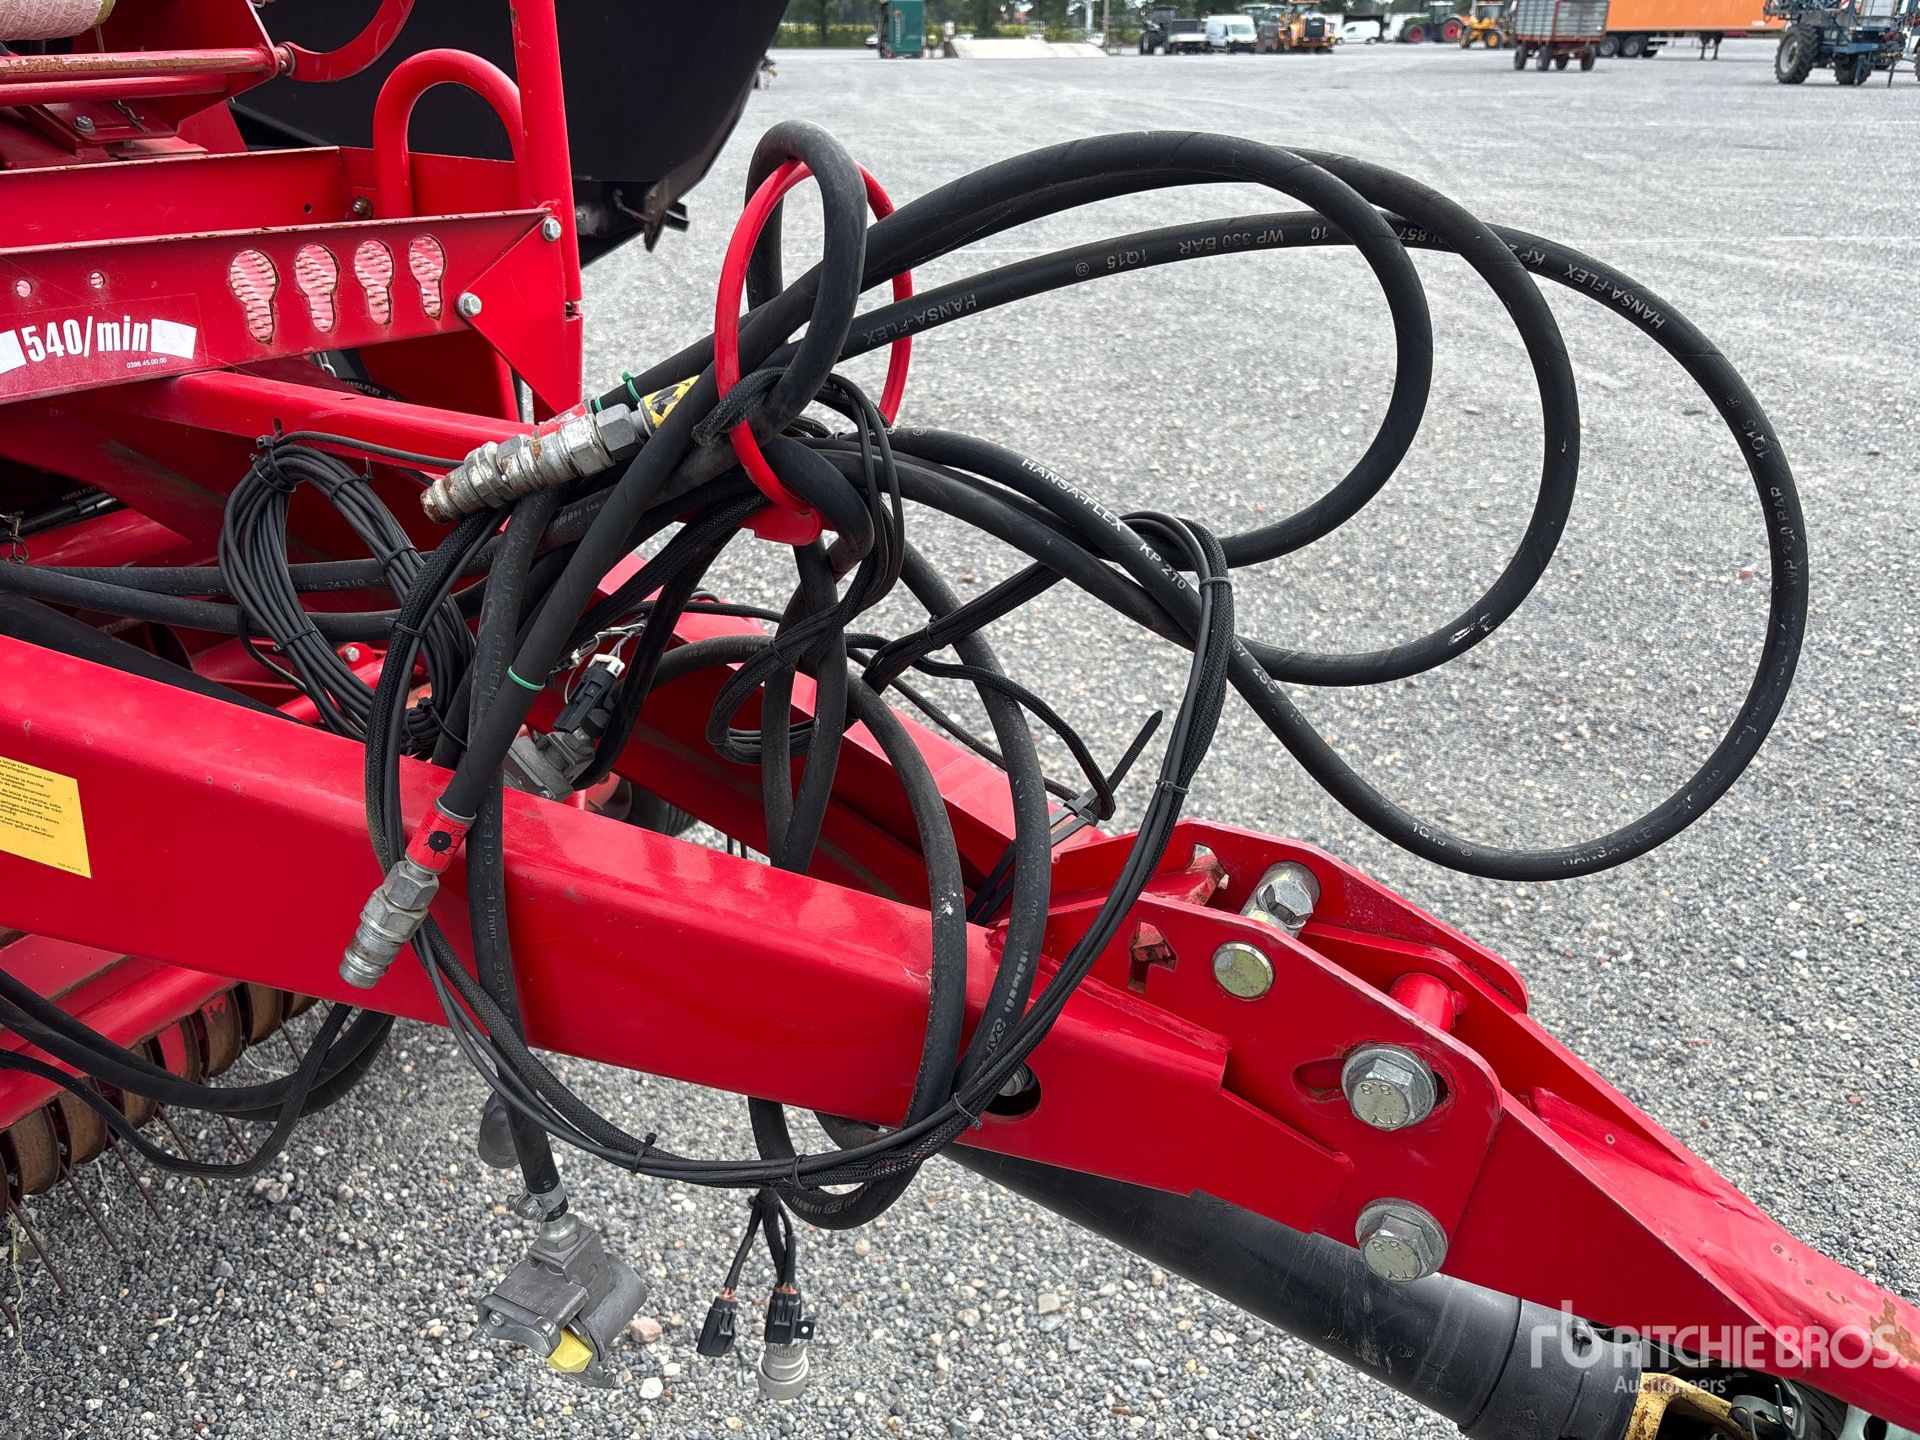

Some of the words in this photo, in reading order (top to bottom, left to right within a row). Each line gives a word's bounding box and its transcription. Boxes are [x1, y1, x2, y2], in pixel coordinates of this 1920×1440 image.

[1222, 231, 1250, 248] 330
[1256, 228, 1284, 244] WP
[1310, 226, 1328, 240] 10
[1399, 227, 1427, 242] 857
[1178, 236, 1217, 255] BAR
[1106, 248, 1149, 270] 1Q15
[1519, 250, 1546, 266] KP
[1563, 263, 1667, 329] HANSA-FLEX
[862, 293, 977, 346] HANSA-FLEX
[23, 315, 149, 363] 540/min
[1021, 458, 1125, 532] HANSA-FLEX
[1139, 542, 1162, 565] KP
[1161, 565, 1188, 591] 210
[1252, 665, 1277, 694] 2SC
